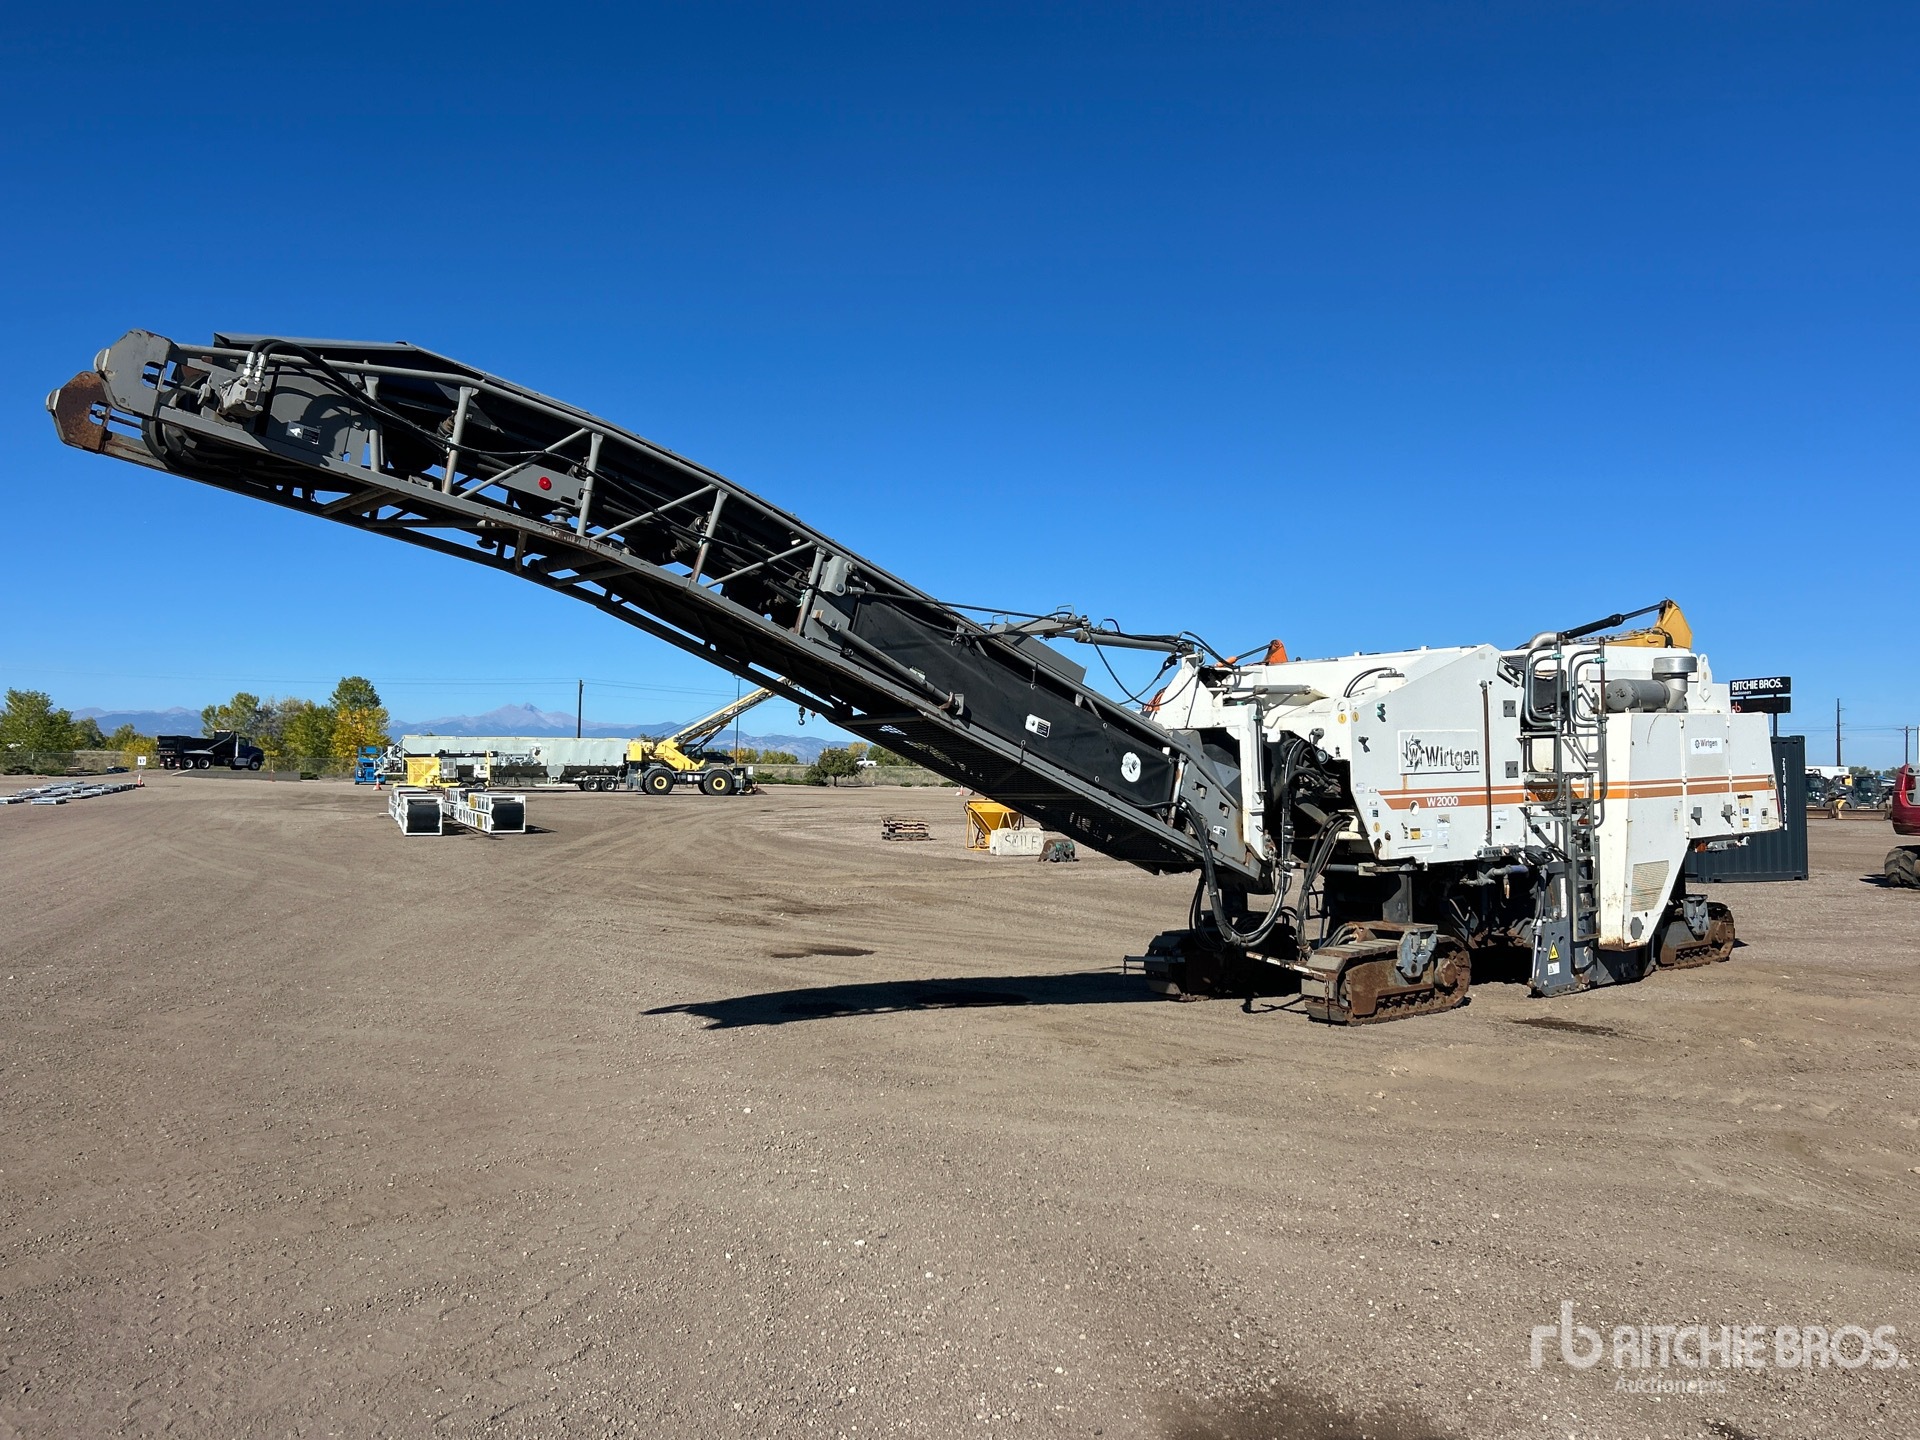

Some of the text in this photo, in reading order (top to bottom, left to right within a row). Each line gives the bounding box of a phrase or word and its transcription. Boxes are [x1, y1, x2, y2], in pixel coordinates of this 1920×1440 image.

[1732, 678, 1783, 690] RITCHIE BROS.
[1425, 745, 1480, 772] Wirtgen
[1426, 796, 1459, 808] W2000
